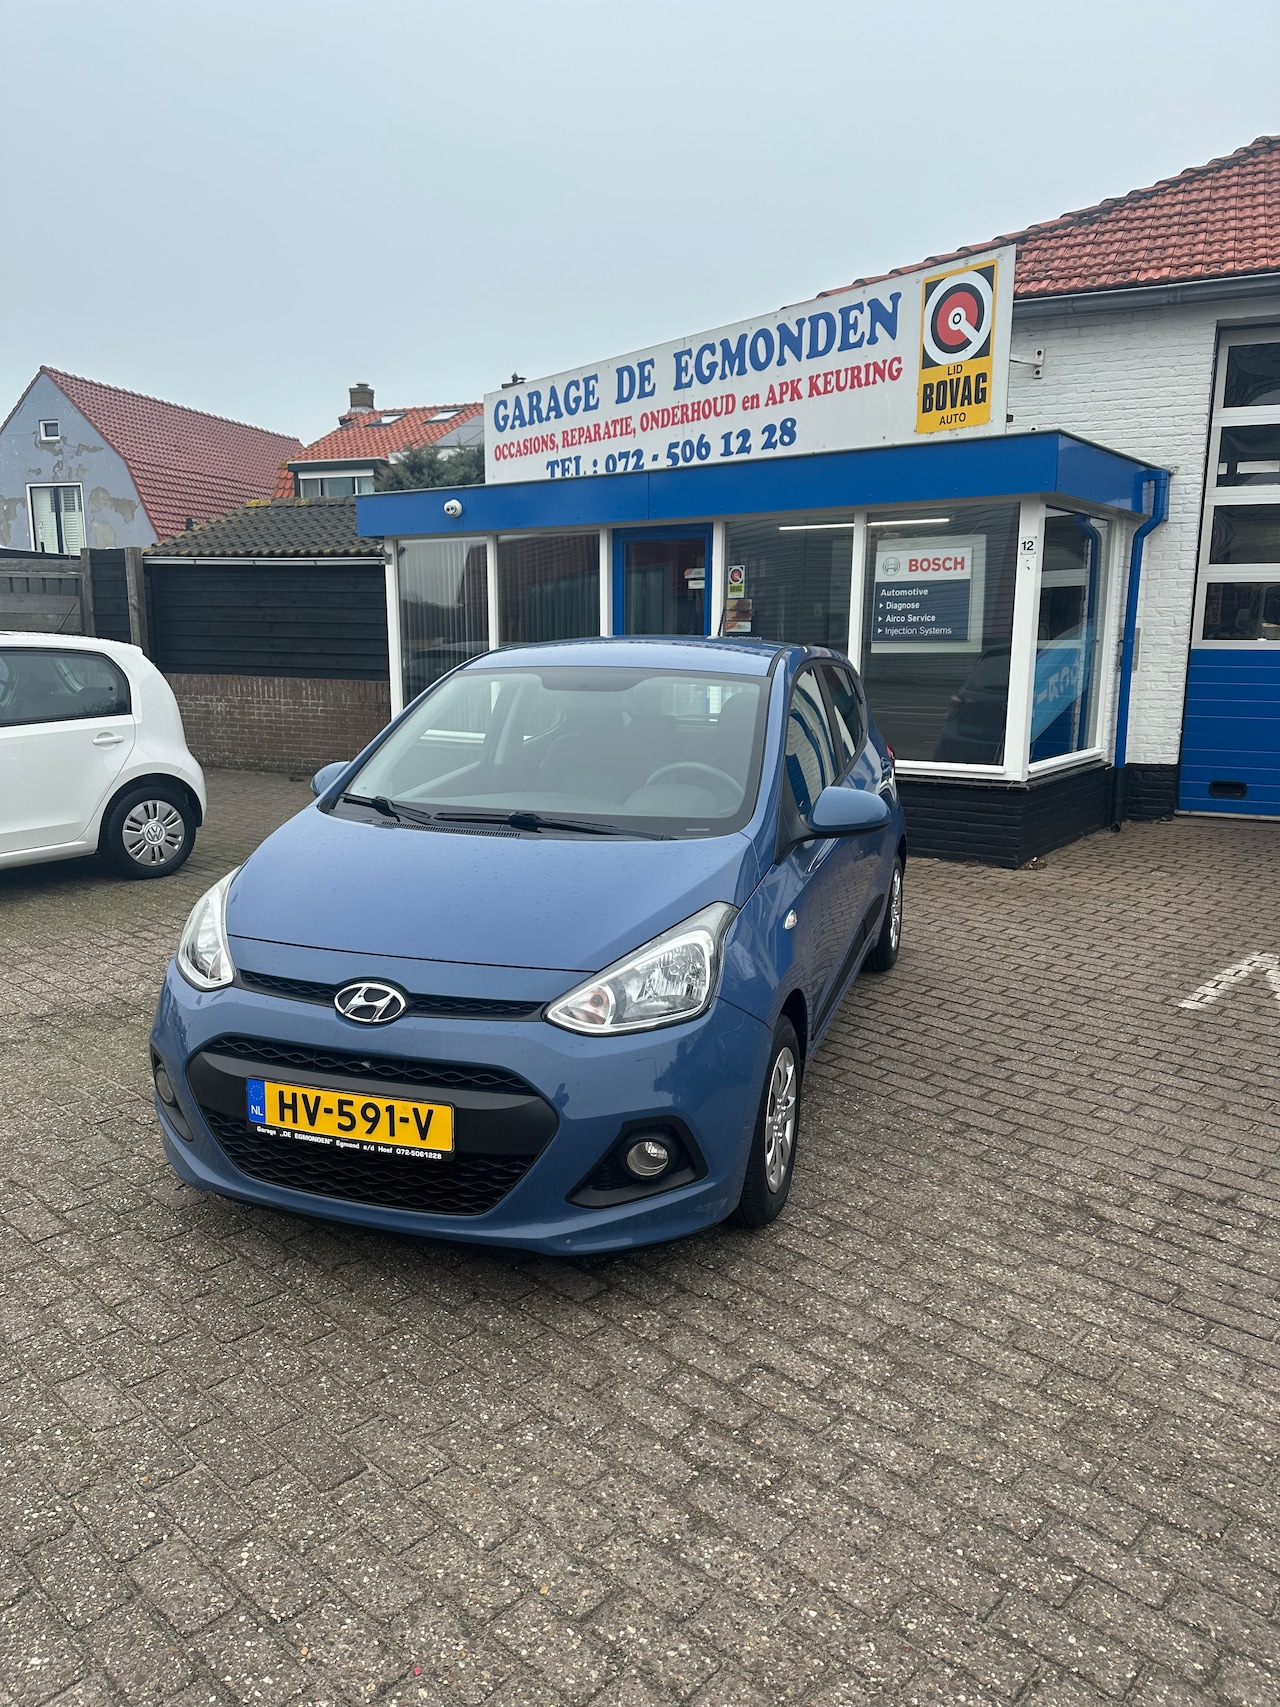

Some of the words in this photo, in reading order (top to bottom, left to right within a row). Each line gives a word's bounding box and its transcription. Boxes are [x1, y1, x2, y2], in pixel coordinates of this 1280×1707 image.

[494, 373, 600, 432] GARAGE
[615, 358, 656, 404] DE
[673, 291, 902, 391] EGMONDEN
[947, 364, 963, 376] LID
[922, 372, 987, 413] BOVAG
[494, 433, 559, 461] OCCASIONS,
[562, 415, 636, 449] REPARATIE,
[640, 393, 736, 432] ONDERHOUD
[742, 392, 760, 411] en
[765, 377, 803, 407] APK
[808, 356, 903, 398] KEURING
[939, 412, 966, 425] AUTO
[605, 448, 645, 473] 072
[666, 433, 711, 467] 506
[720, 428, 752, 457] 12
[761, 417, 797, 450] 28
[1022, 540, 1034, 551] 12
[908, 556, 965, 573] BOSCH
[880, 587, 929, 597] Automotive
[886, 601, 920, 611] Diagnose
[885, 614, 905, 622] Airco
[907, 613, 936, 622] Service
[885, 626, 917, 636] Injection
[919, 626, 952, 636] Systems
[250, 1104, 264, 1116] NL
[278, 1090, 434, 1141] HV-591-V
[256, 1126, 277, 1136] Garage
[336, 1140, 360, 1149] Egmond
[378, 1146, 393, 1154] Hoef
[396, 1149, 442, 1160] 072-5061228
